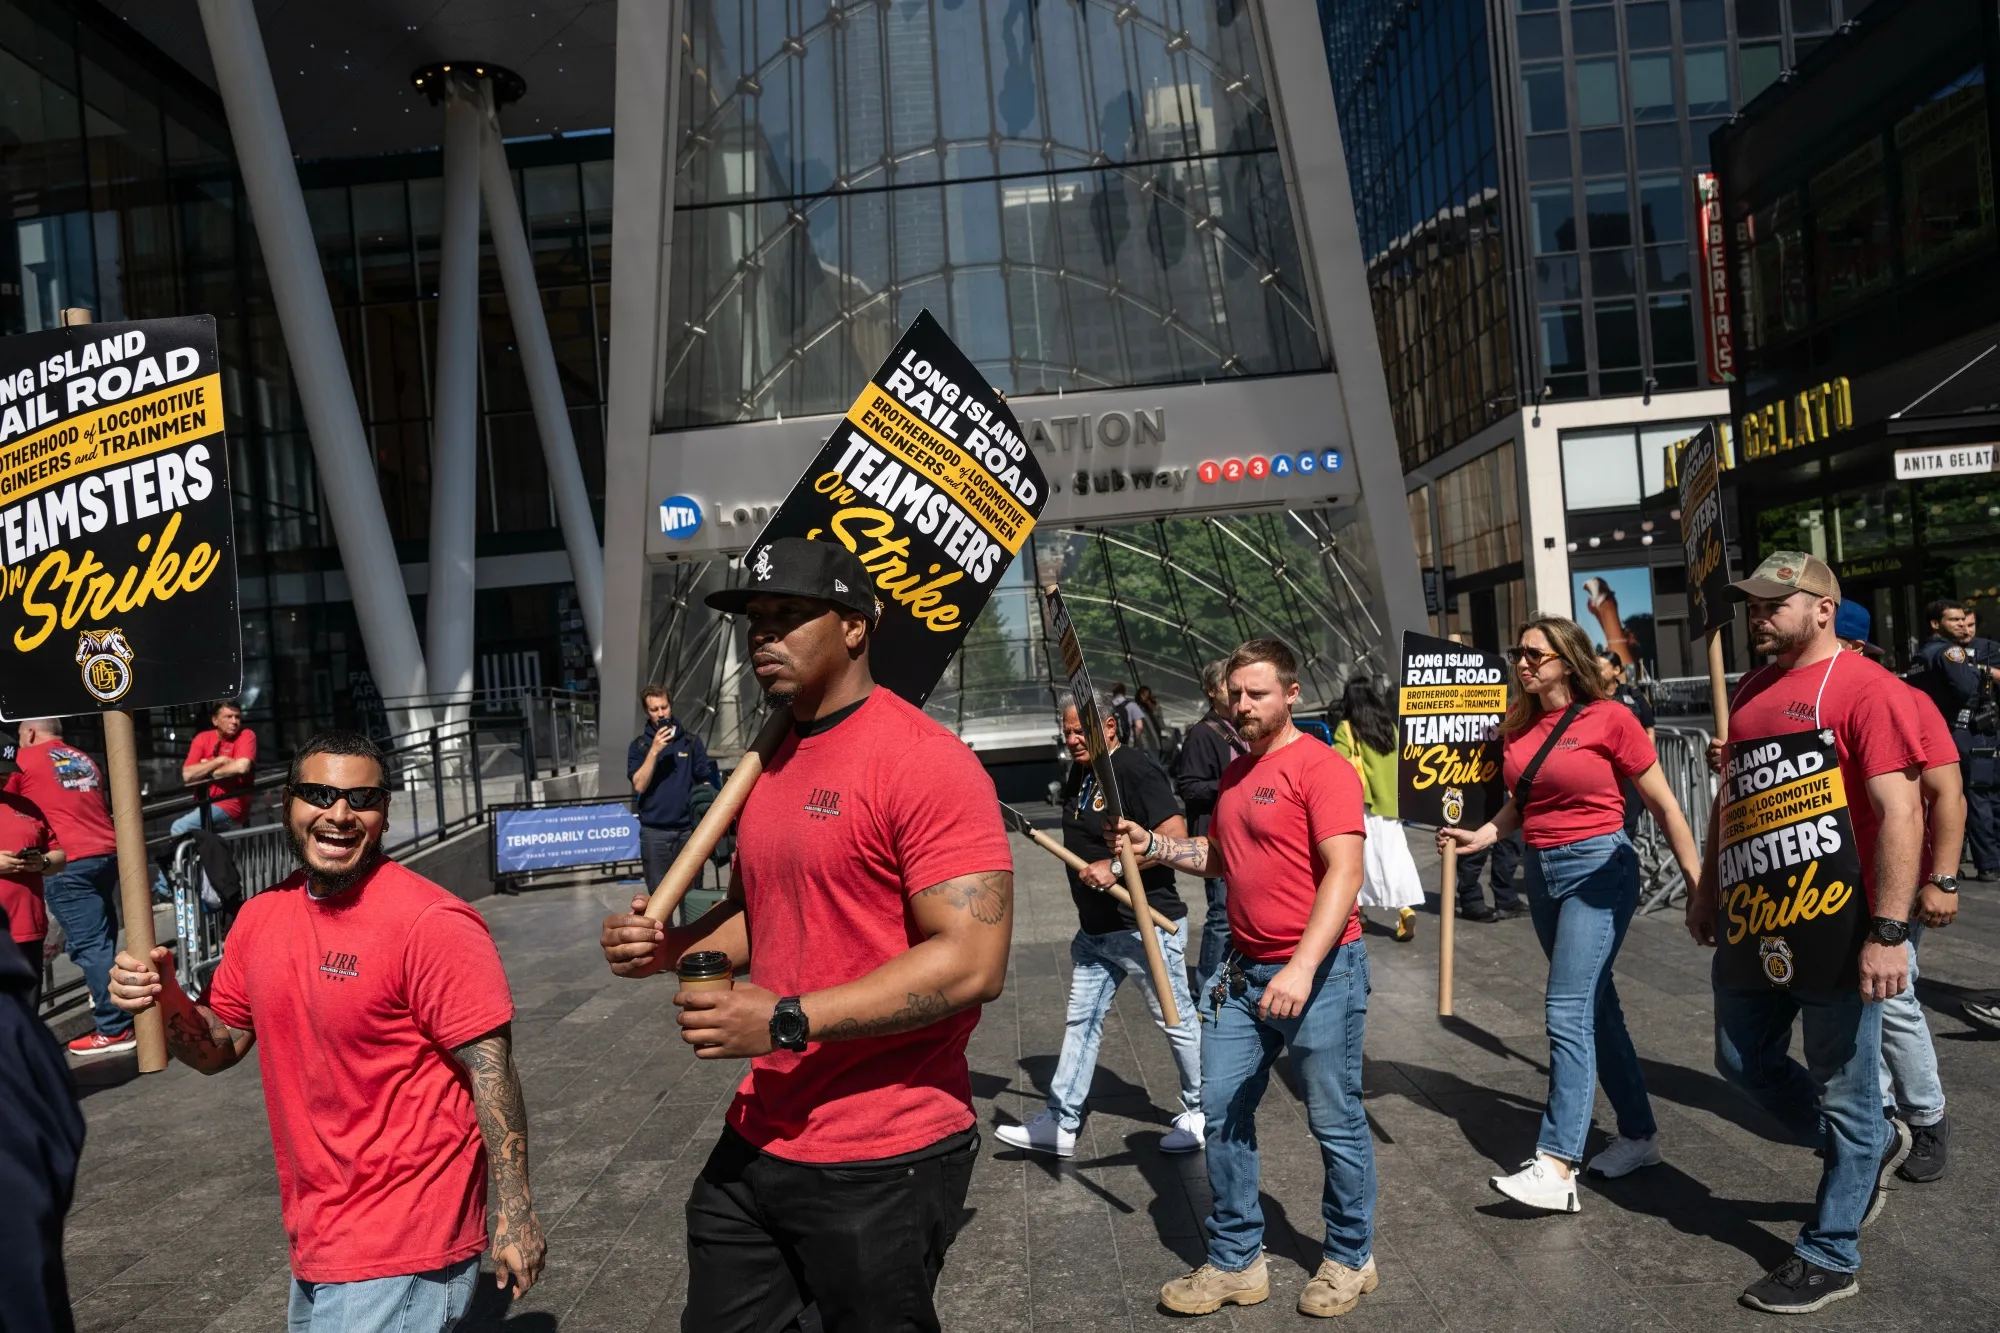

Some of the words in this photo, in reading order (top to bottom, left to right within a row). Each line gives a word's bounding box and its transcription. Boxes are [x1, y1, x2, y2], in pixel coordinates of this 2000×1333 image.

[1707, 177, 1732, 369] ROBERTA'S
[0, 368, 35, 406] NG
[40, 330, 146, 389] ISLAND
[0, 392, 59, 442] AIL
[67, 346, 200, 413] ROAD
[901, 349, 960, 405] LONG
[959, 394, 1026, 462] ISLAND
[0, 427, 79, 474] THERHOOD
[84, 424, 96, 446] of
[98, 386, 205, 434] LOCOMOTIVE
[884, 368, 958, 439] RAIL
[963, 430, 1037, 506] ROAD
[1018, 407, 1166, 453] ATION
[1742, 376, 1853, 463] GELATO
[0, 454, 72, 496] GINEERS
[75, 444, 98, 466] and
[100, 409, 207, 458] TRAINMEN
[871, 396, 961, 466] BROTHERHOOD
[959, 465, 969, 479] of
[967, 465, 1026, 528] LOCOMOTIVE
[1904, 453, 1943, 472] ANITA
[1949, 450, 1999, 467] GELATO
[815, 471, 857, 505] On
[861, 411, 945, 477] ENGINEERS
[943, 473, 960, 491] and
[958, 482, 1017, 542] TRAINMEN
[1072, 466, 1189, 496] Subway
[660, 505, 697, 533] MTA
[833, 431, 1000, 583] TEAMSTERS
[13, 511, 220, 653] Strike
[807, 506, 961, 632] Strike
[1407, 669, 1452, 685] RAIL
[1456, 668, 1501, 684] ROAD
[1408, 654, 1442, 668] LONG
[1445, 653, 1484, 667] ISLAND
[1406, 700, 1455, 711] ENGINEERS
[1464, 699, 1500, 709] TRAINMEN
[1407, 689, 1459, 700] BROTHERHOOD
[1464, 689, 1501, 699] LOCOMOTIVE
[1403, 742, 1424, 760] On
[1405, 714, 1500, 745] TEAMSTERS
[1412, 743, 1499, 790] Strike
[1726, 742, 1782, 780] ISLAND
[1738, 751, 1824, 798] ROAD
[809, 788, 840, 809] LIRR
[1255, 786, 1276, 799] LIRR
[1746, 817, 1758, 831] and
[1758, 791, 1833, 826] TRAINMEN
[1749, 804, 1756, 819] of
[1755, 776, 1831, 812] LOCOMOTIVE
[506, 830, 584, 847] TEMPORARILY
[587, 826, 630, 840] CLOSED
[177, 889, 186, 936] NYPD
[1726, 860, 1852, 945] Strike
[187, 903, 196, 949] NYPD
[325, 950, 357, 970] LIRR
